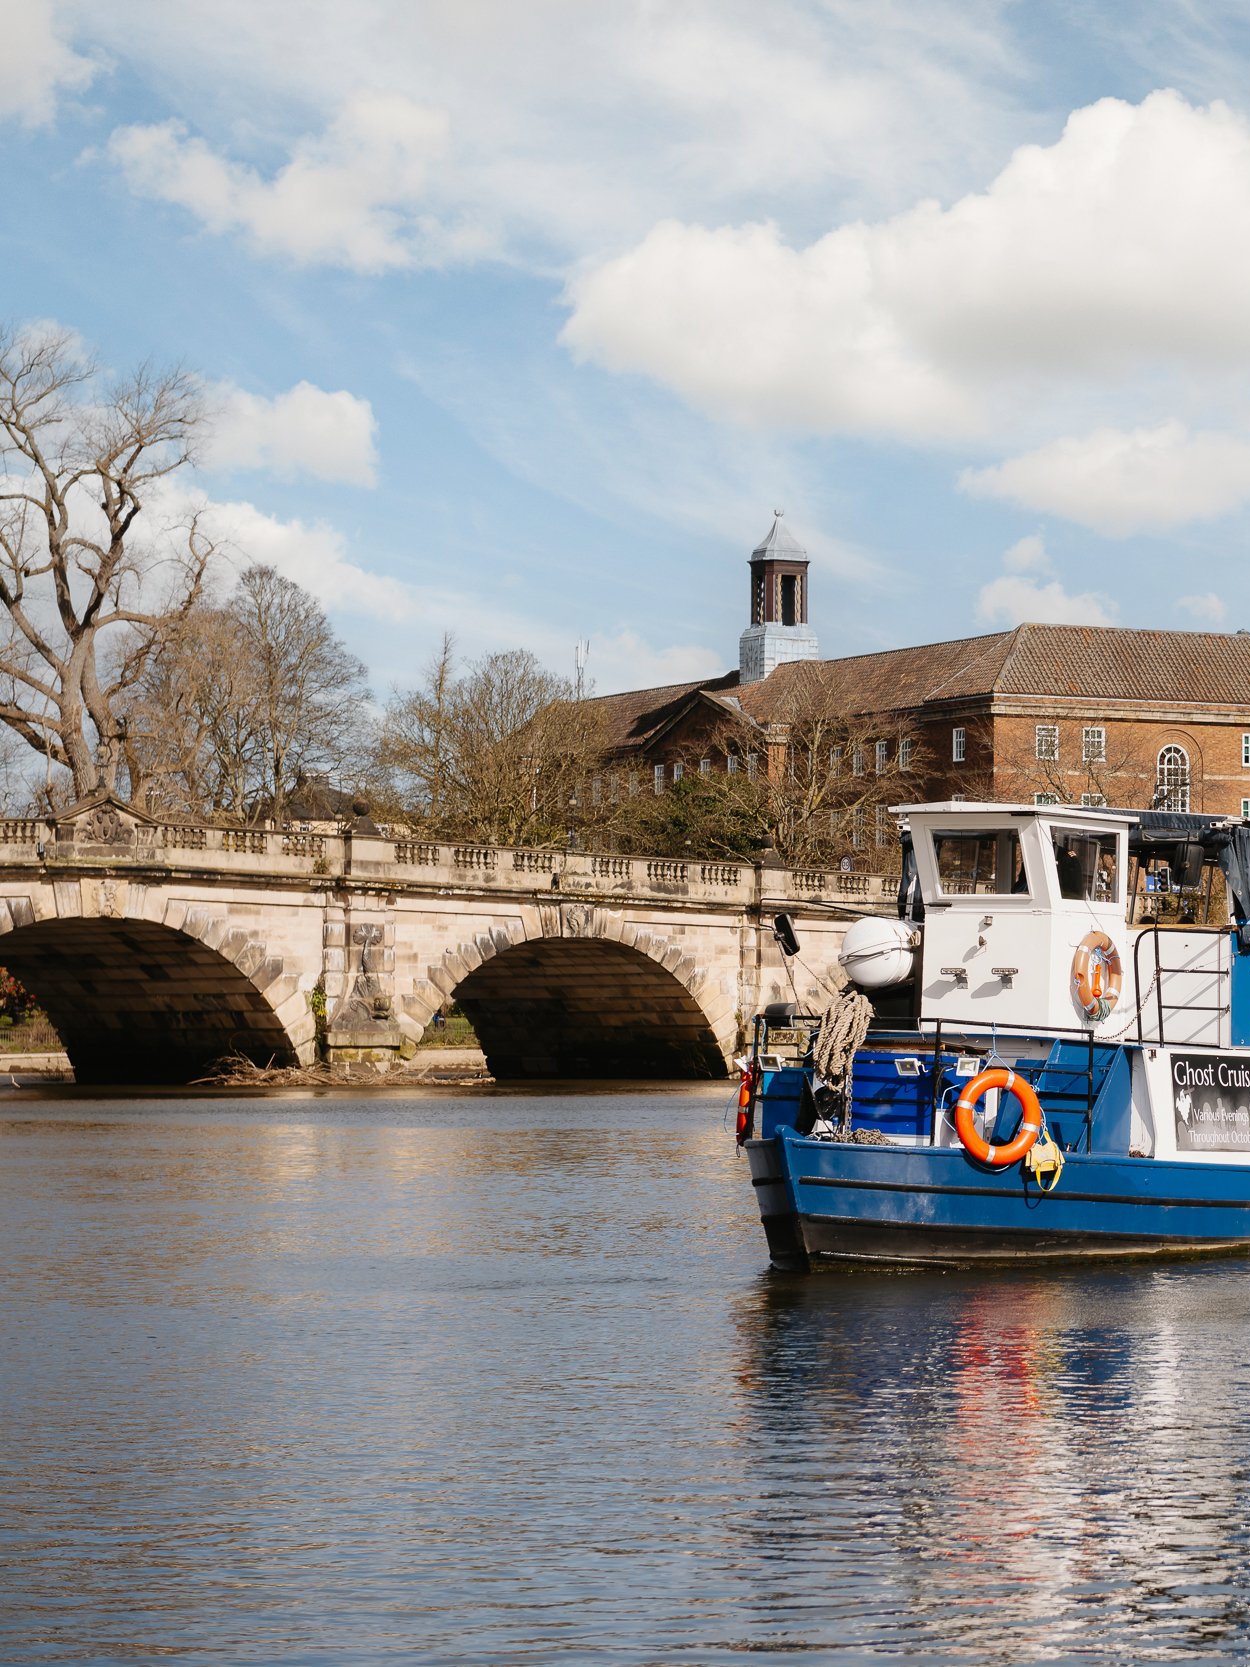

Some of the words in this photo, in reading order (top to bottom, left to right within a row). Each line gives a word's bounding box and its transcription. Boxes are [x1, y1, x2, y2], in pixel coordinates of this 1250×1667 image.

[1173, 1061, 1216, 1086] Ghost
[1193, 1108, 1220, 1122] Various
[1221, 1109, 1249, 1126] Evenings
[1188, 1130, 1230, 1146] Throughout
